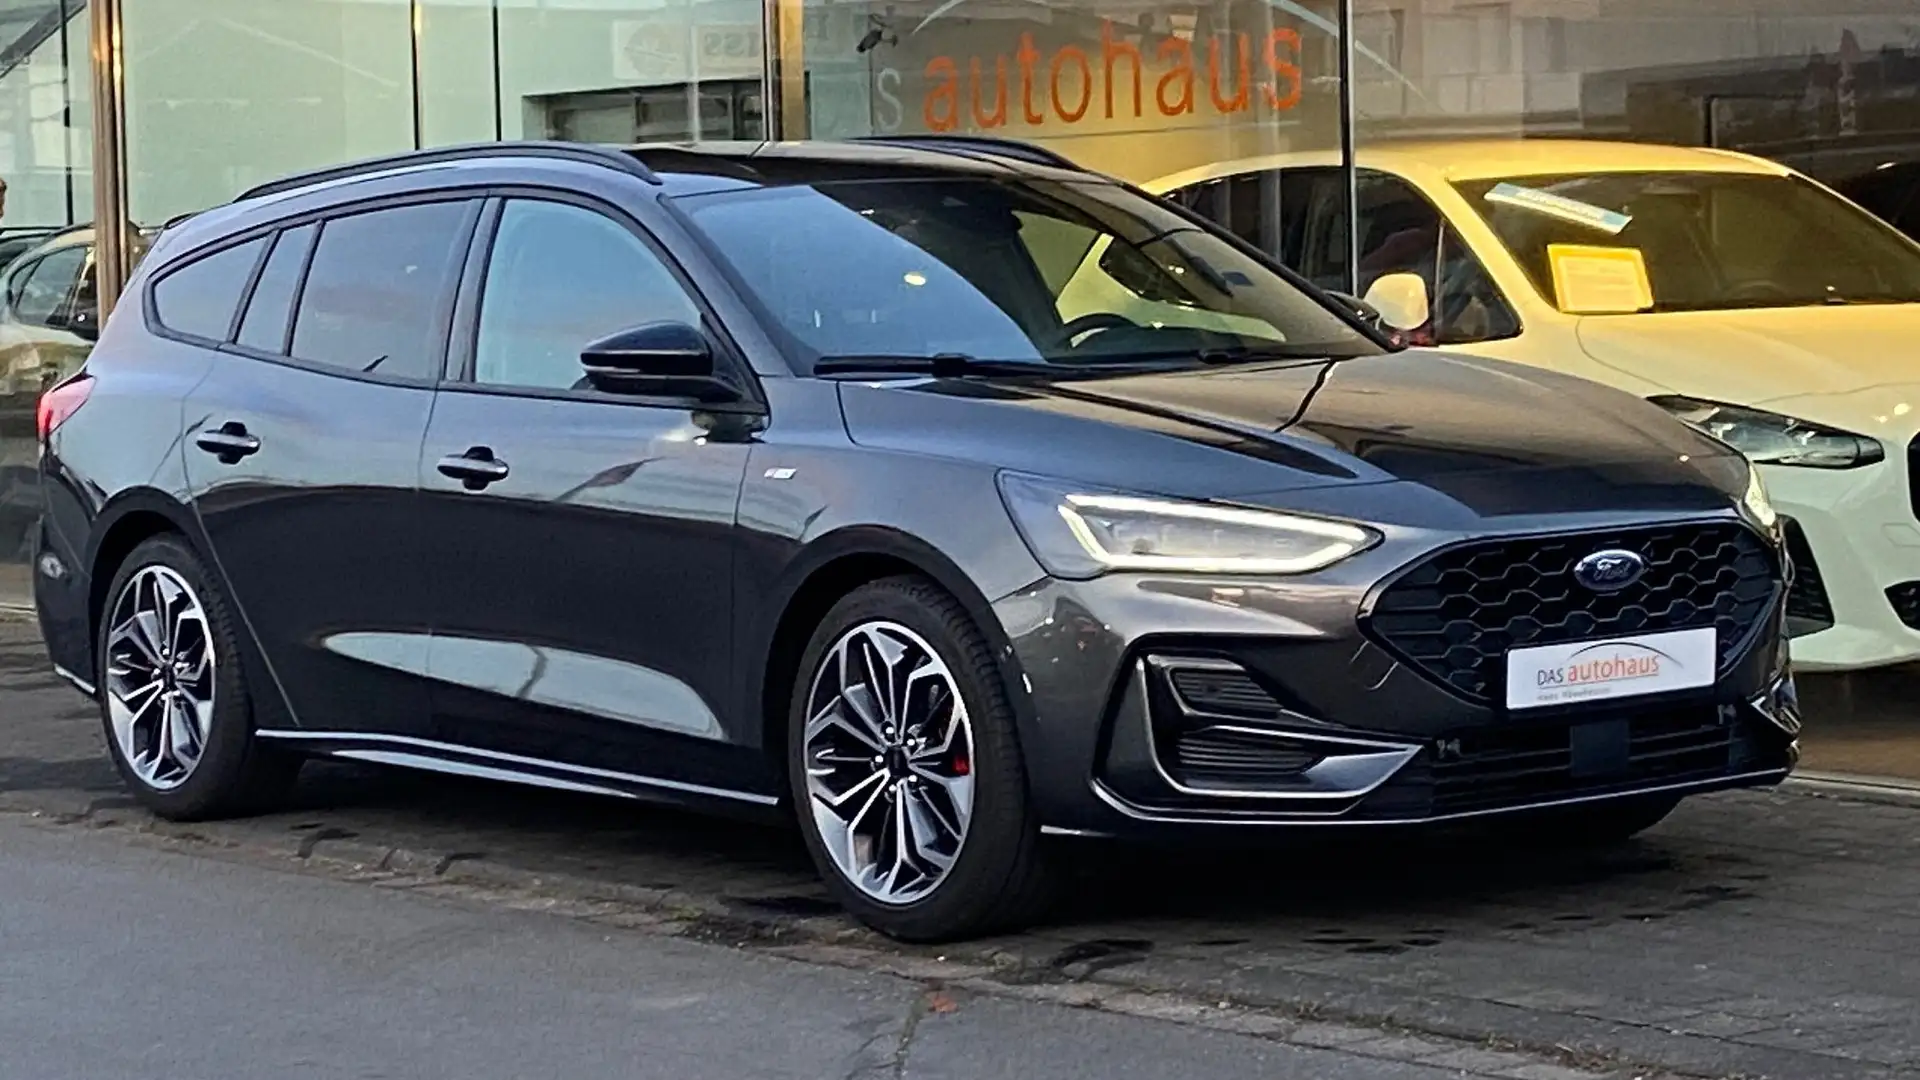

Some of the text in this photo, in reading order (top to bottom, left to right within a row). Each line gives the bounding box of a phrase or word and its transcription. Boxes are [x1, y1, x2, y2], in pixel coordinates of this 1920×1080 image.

[922, 19, 1302, 132] autohaus
[1537, 653, 1660, 685] DAS autohaus
